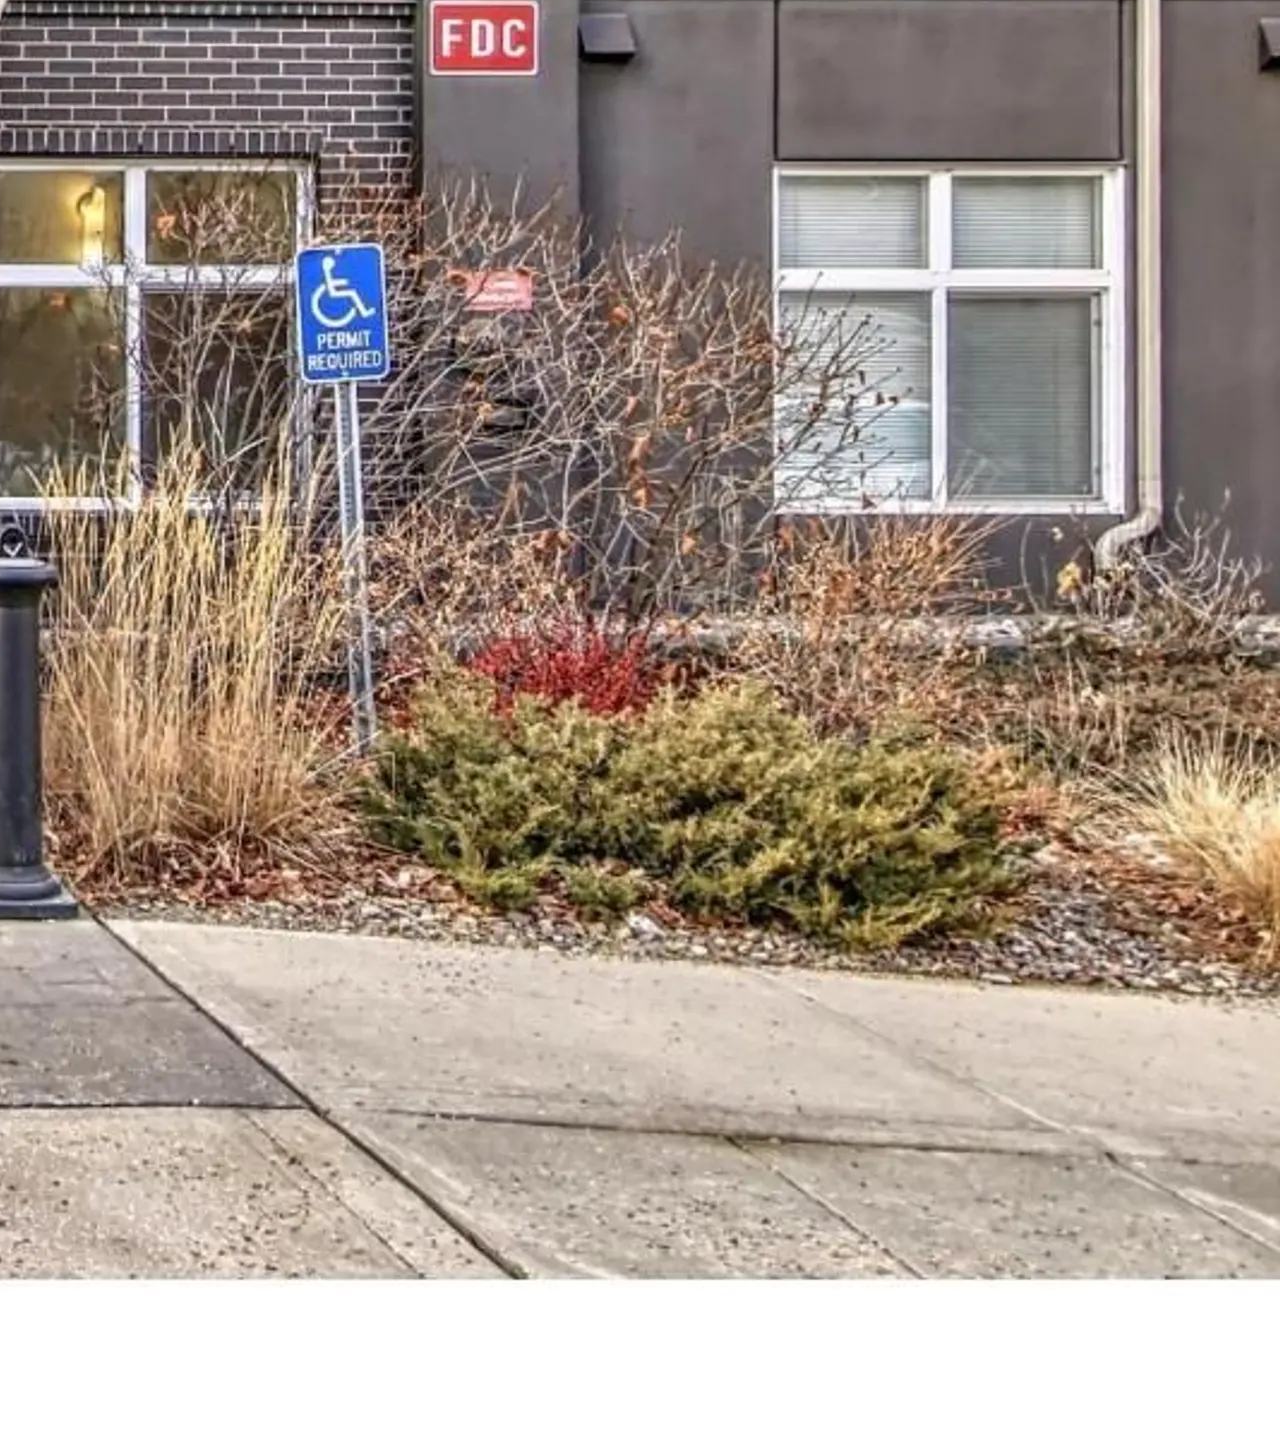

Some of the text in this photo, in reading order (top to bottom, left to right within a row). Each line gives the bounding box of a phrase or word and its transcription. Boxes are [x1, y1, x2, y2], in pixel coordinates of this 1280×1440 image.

[442, 19, 526, 58] FDC
[317, 329, 372, 351] PERMIT
[307, 350, 382, 372] REQUIRED
